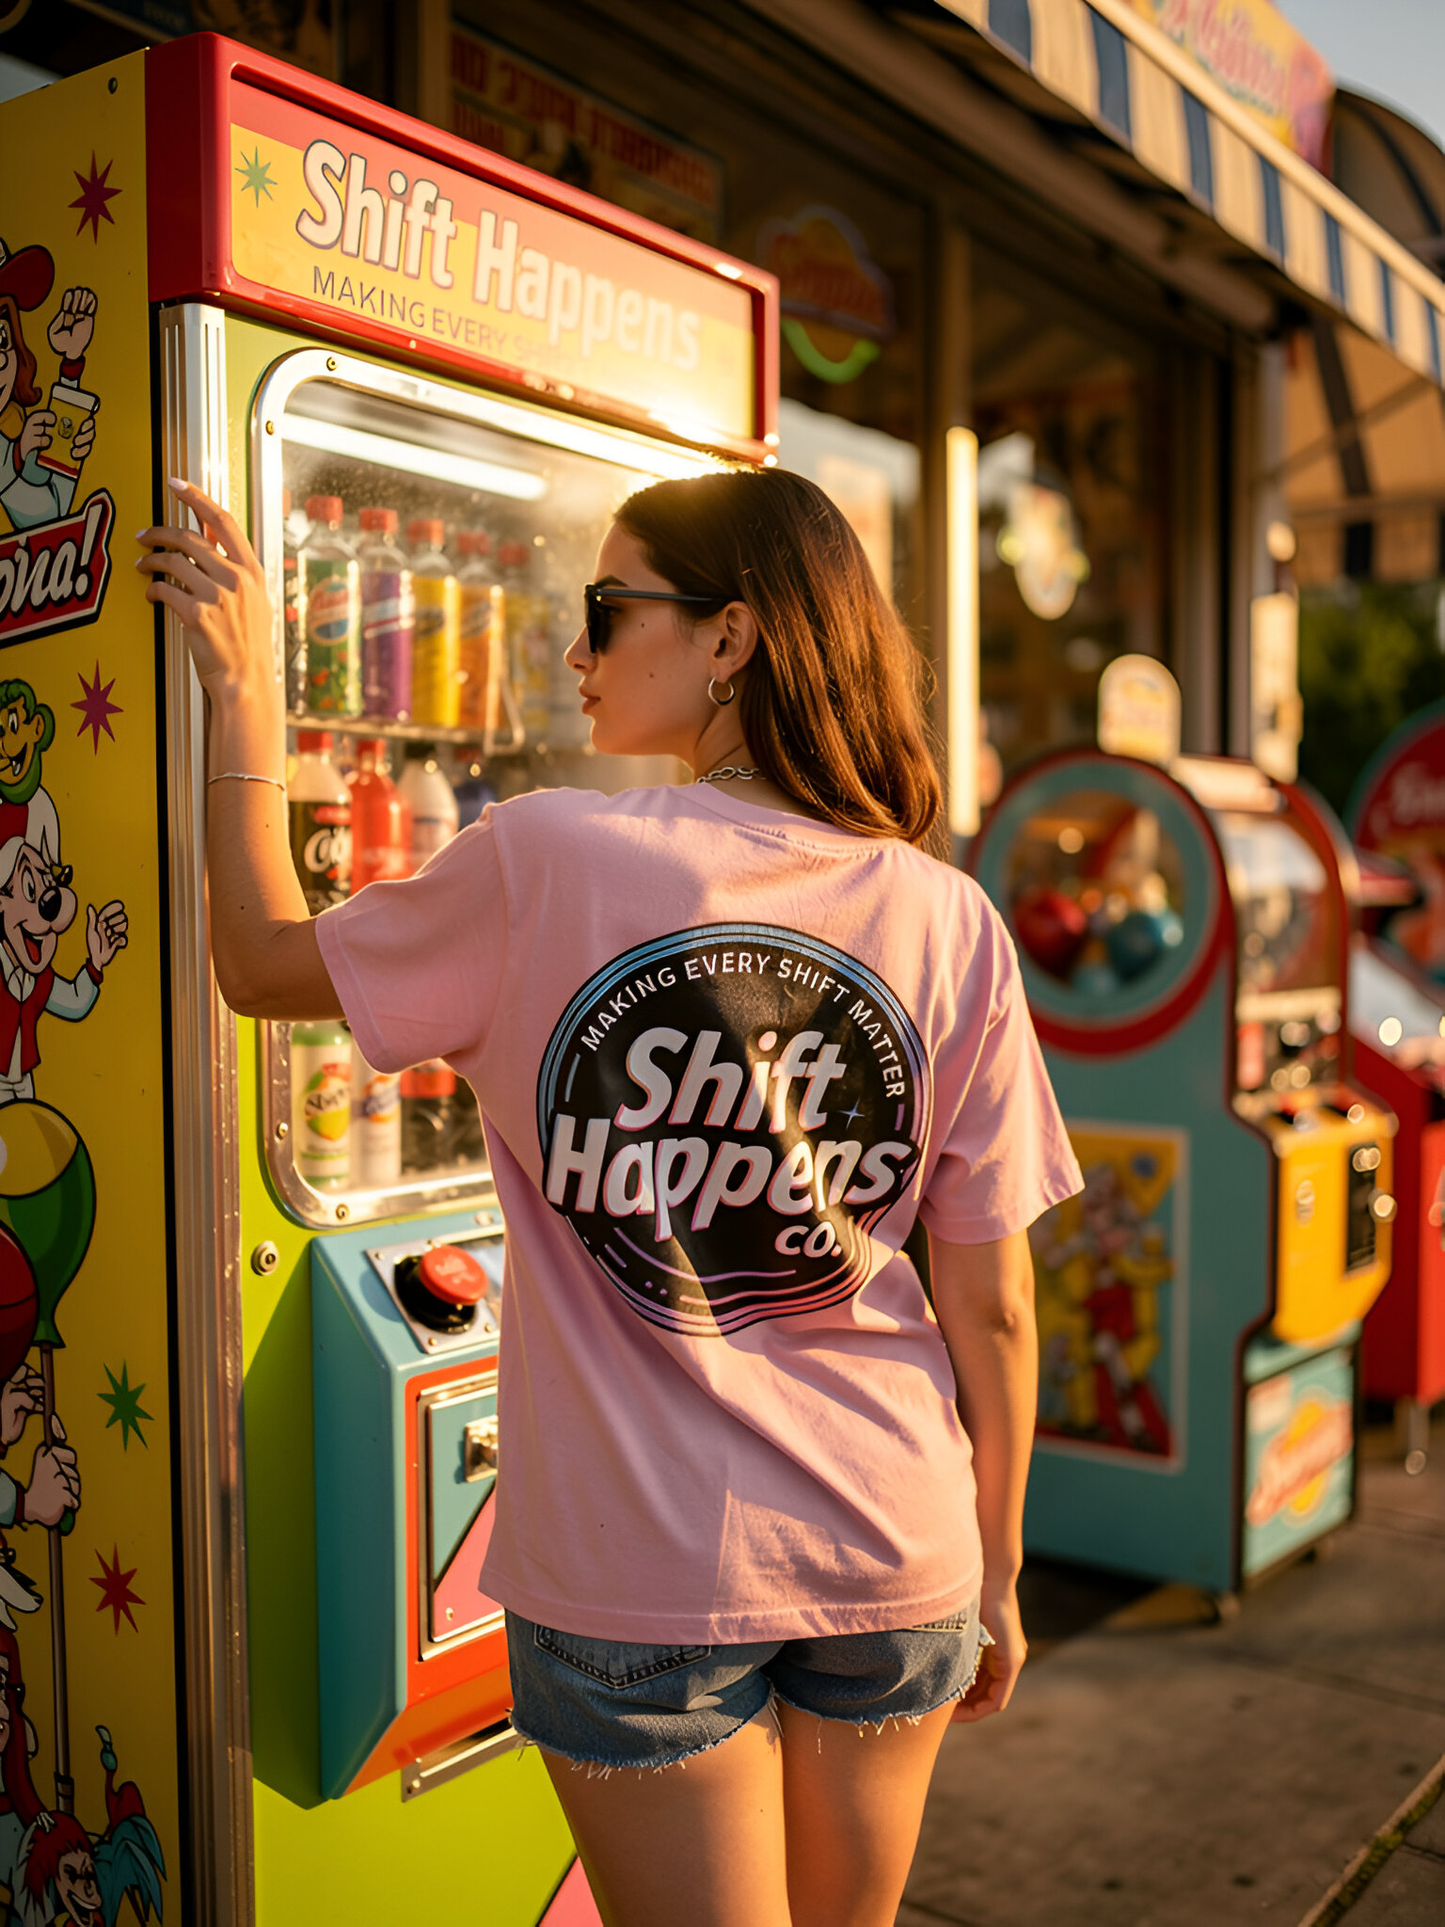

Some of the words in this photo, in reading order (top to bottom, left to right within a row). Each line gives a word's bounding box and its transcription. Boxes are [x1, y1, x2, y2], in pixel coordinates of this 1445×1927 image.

[296, 139, 458, 289] Shift
[473, 209, 700, 371] Happens
[313, 265, 425, 328] MAKING
[432, 307, 508, 353] EVERY
[580, 967, 677, 1052] MAKING
[684, 951, 771, 981] EVERY
[777, 958, 851, 1003] SHIFT
[848, 1000, 906, 1098] MATTER
[613, 1026, 847, 1134] Shift
[546, 1113, 913, 1242] Happens
